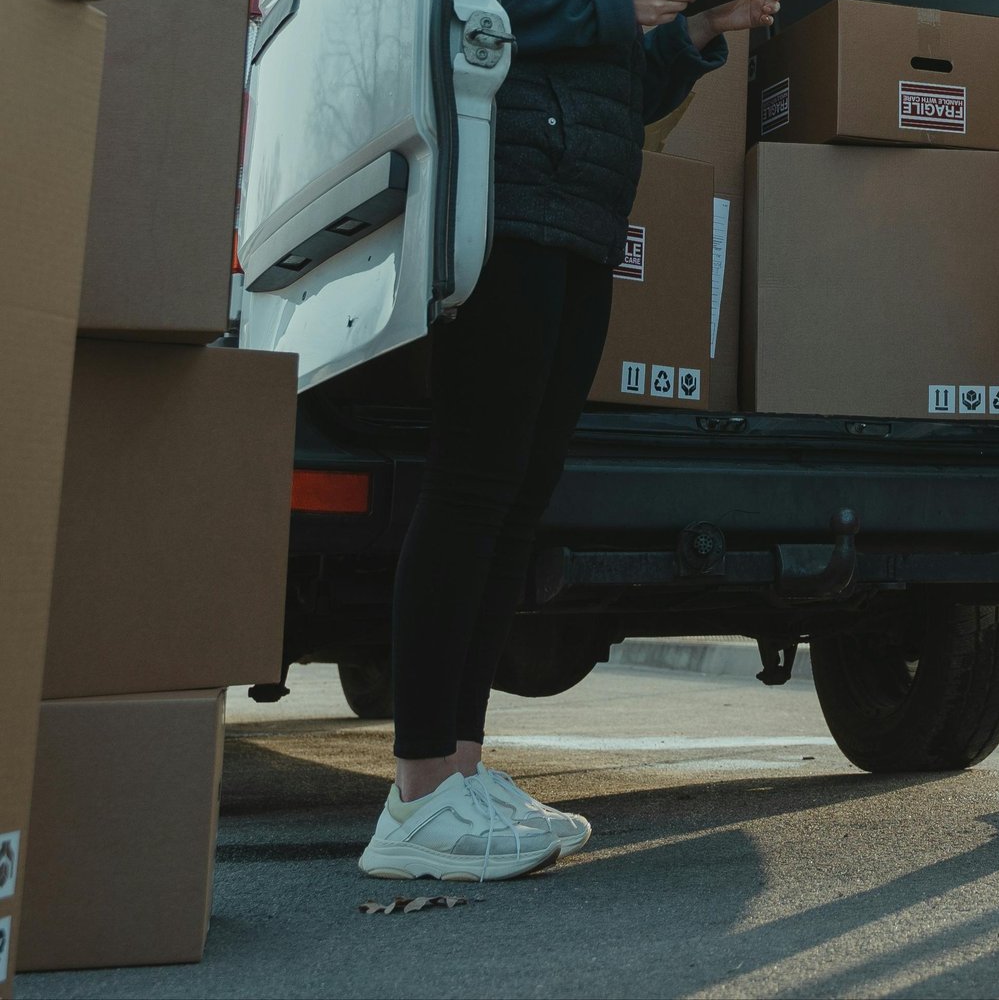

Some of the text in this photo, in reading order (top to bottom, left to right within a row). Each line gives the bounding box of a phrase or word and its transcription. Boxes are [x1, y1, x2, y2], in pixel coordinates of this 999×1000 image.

[902, 95, 963, 106] HANDLE WITH CARE
[903, 102, 962, 118] FRAGILE
